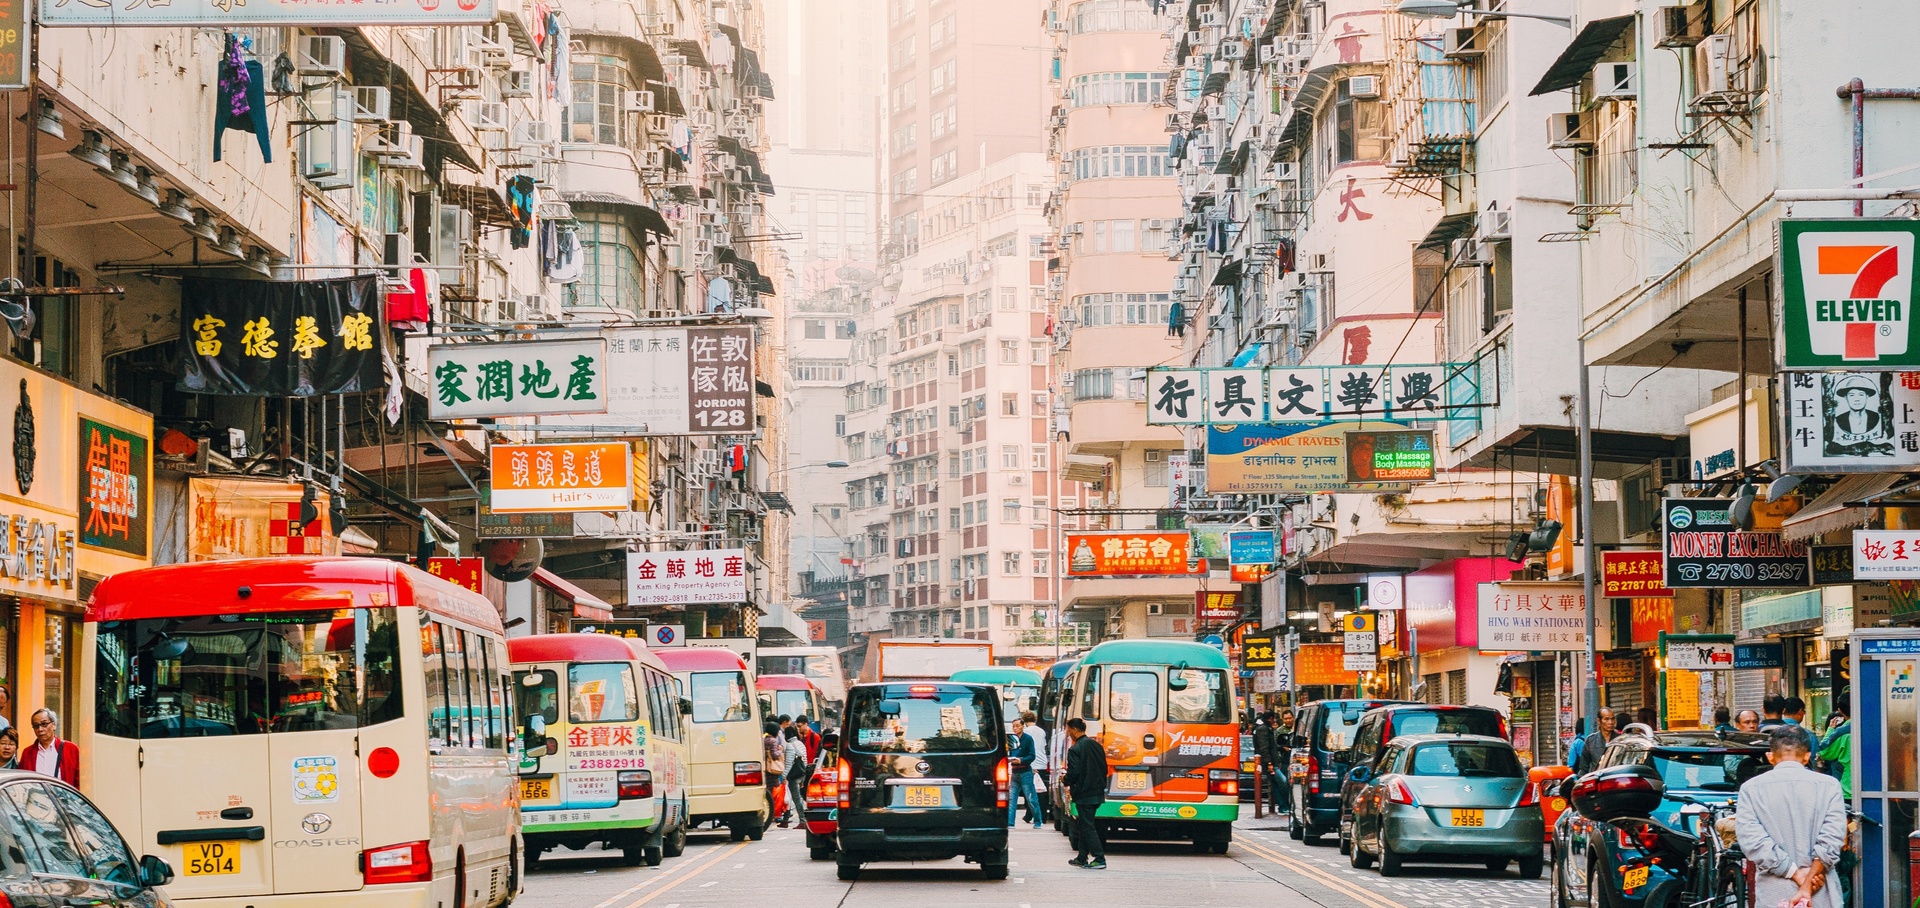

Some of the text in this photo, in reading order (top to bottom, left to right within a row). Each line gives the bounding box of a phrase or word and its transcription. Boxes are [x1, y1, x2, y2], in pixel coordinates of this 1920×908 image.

[1818, 246, 1898, 358] 7
[193, 312, 374, 359] 富德拳館
[611, 338, 680, 354] 雅蘭床褥
[691, 336, 748, 362] 佐敦
[435, 355, 597, 407] 家潤地產
[691, 366, 749, 394] 傢俬
[695, 399, 746, 408] JORDON
[695, 410, 746, 427] 128
[1243, 437, 1340, 446] DYNAMIC TRAVELS
[1375, 453, 1393, 461] Foot
[511, 450, 603, 487] 頭頭是道
[1376, 460, 1431, 469] Body Massage
[552, 492, 592, 503] Hair's
[1669, 532, 1809, 558] MONEY EXCHANGE
[1706, 563, 1805, 580] 2780 3287
[1621, 581, 1645, 590] 2787
[1207, 594, 1236, 608] 惠康
[1488, 617, 1603, 627] HING WAH STATIONERY O.
[568, 726, 633, 748] 金寶來
[1181, 735, 1233, 744] LALAMOVE
[580, 758, 645, 769] 23882918
[527, 782, 542, 790] FG
[521, 789, 549, 798] 1566
[915, 788, 931, 797] ML
[908, 796, 939, 805] 3858
[1461, 809, 1475, 818] UJ
[1454, 817, 1483, 826] 7995
[273, 837, 360, 848] COASTER
[200, 844, 224, 858] VD
[191, 858, 233, 874] 5614
[1630, 869, 1643, 879] PP
[1625, 876, 1647, 889] 6829
